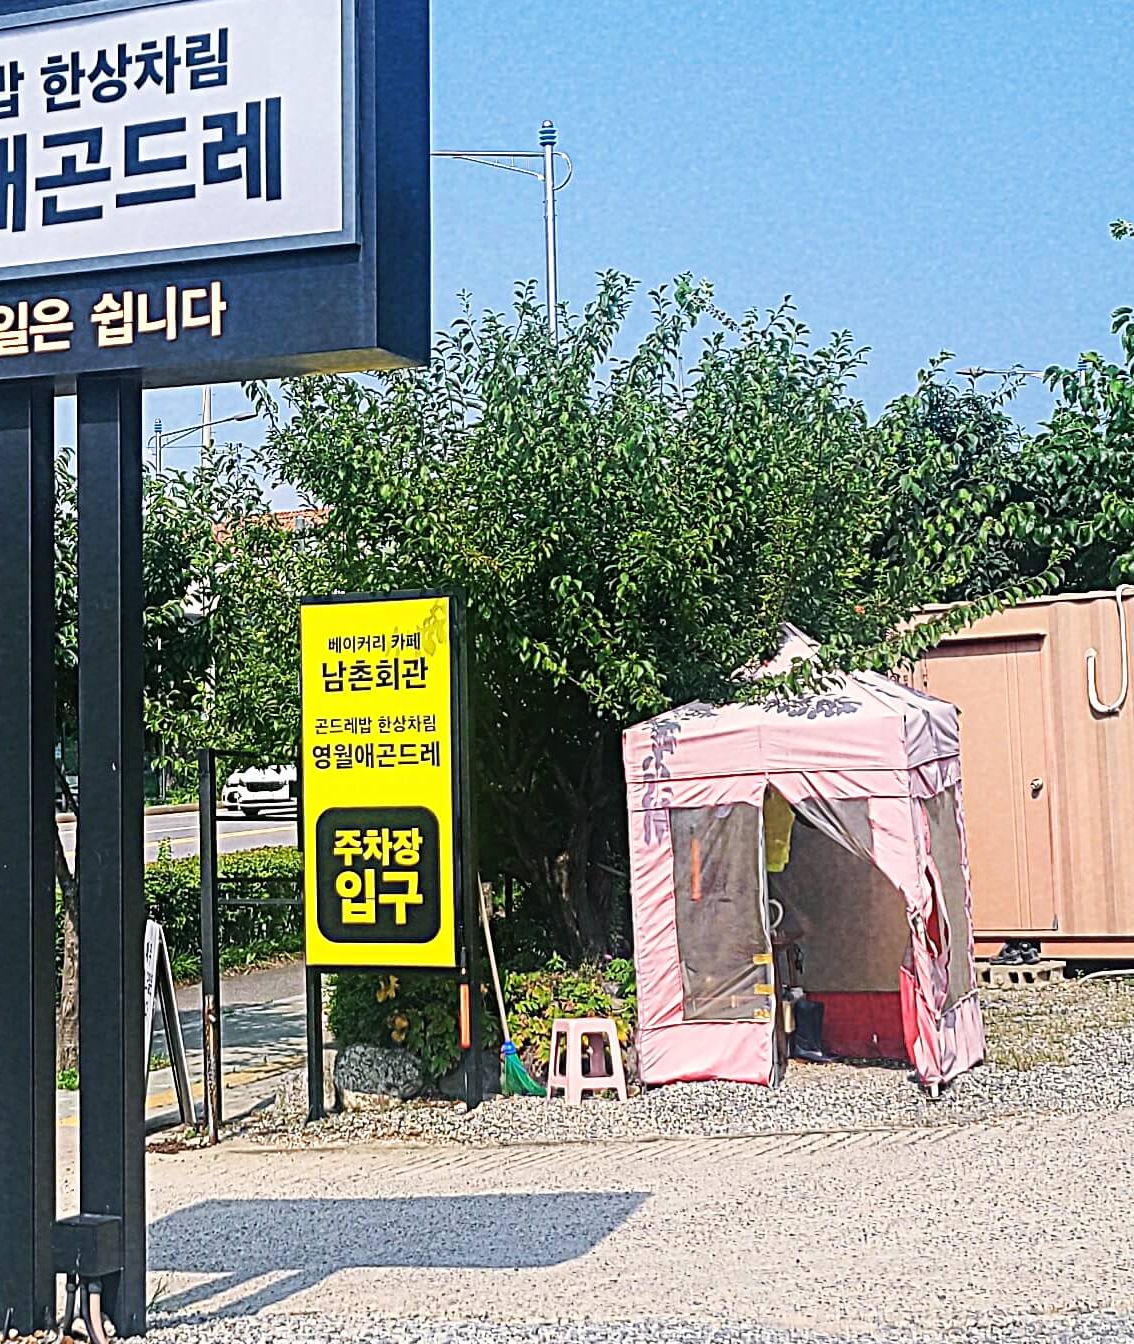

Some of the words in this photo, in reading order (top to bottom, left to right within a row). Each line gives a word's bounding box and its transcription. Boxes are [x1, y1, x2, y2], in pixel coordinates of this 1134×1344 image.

[41, 28, 228, 112] 한상차림
[91, 282, 226, 346] 쉽니다
[329, 635, 385, 653] 베이커리
[392, 632, 420, 650] 카페
[323, 657, 428, 692] 남촌회관
[315, 717, 372, 734] 곤드레밥
[378, 715, 435, 733] 한상차림
[313, 742, 440, 769] 영월애곤드레
[334, 828, 422, 867] 주차장
[336, 869, 423, 924] 입구
